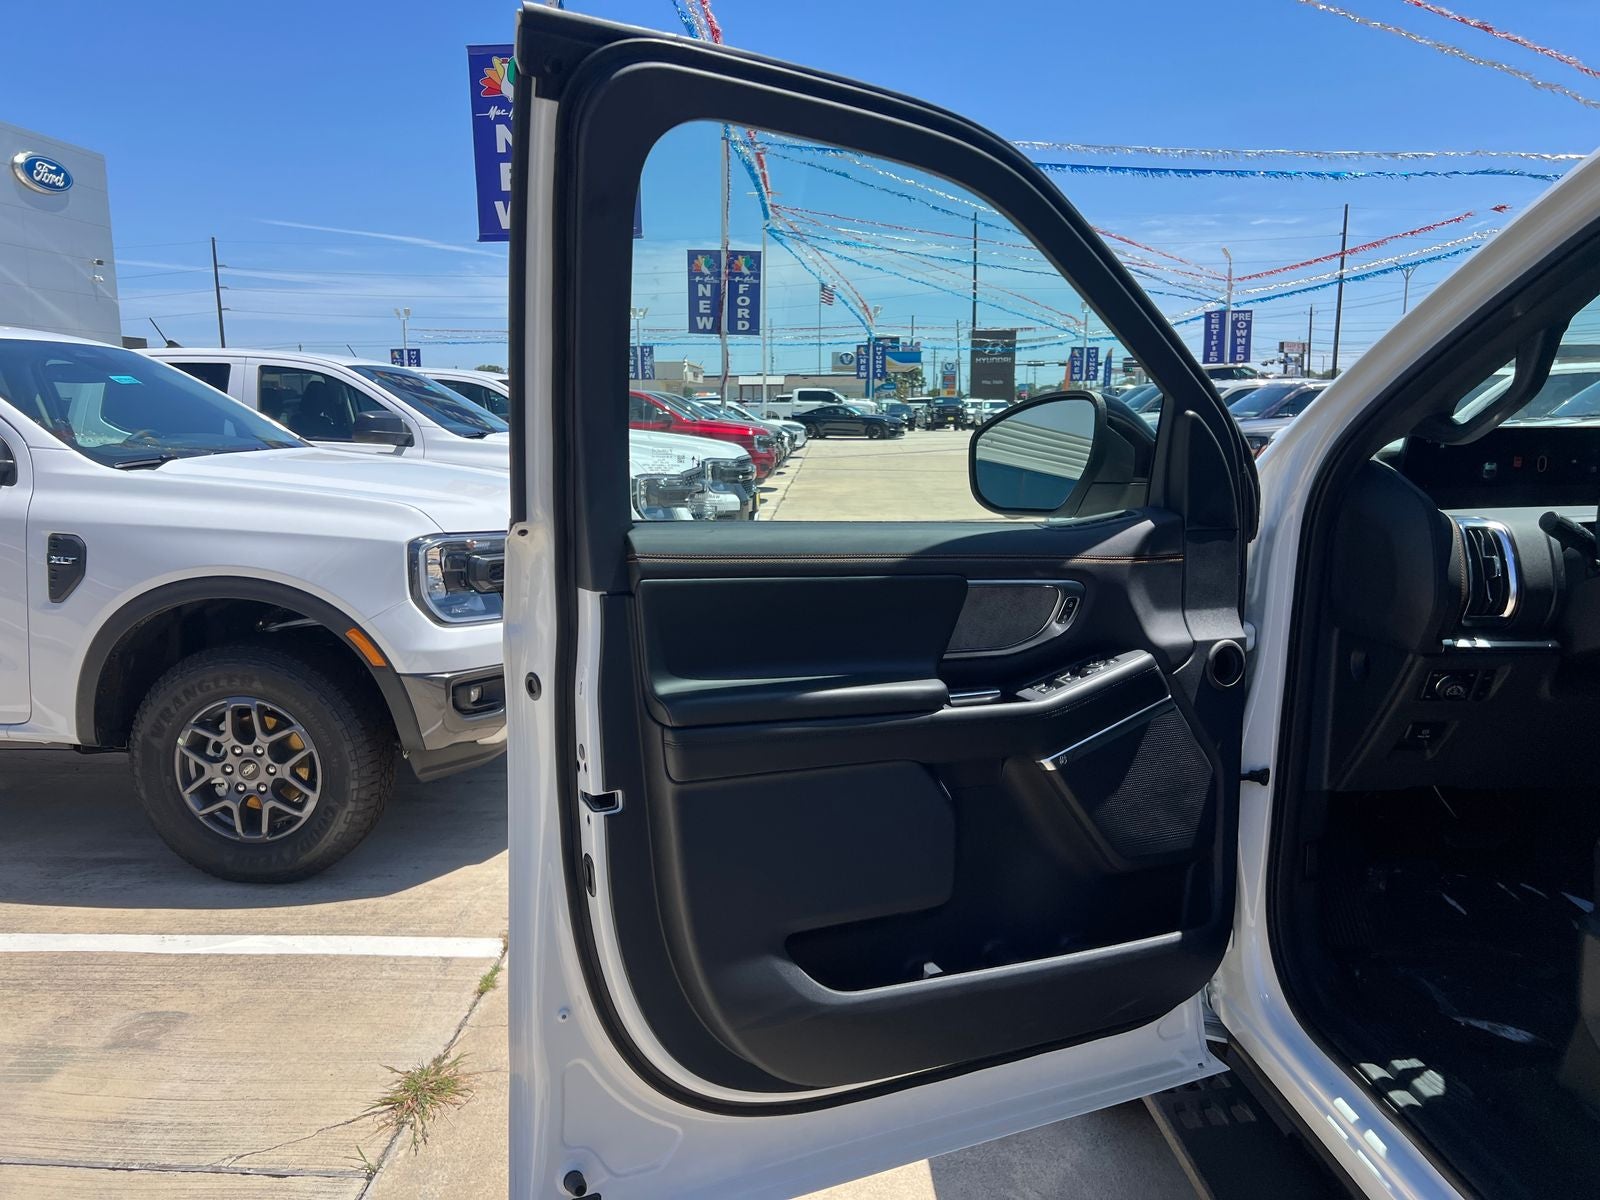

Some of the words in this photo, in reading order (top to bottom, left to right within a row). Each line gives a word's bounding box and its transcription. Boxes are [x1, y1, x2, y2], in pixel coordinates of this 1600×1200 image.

[33, 161, 65, 187] Ford
[696, 284, 714, 330] NEW
[736, 284, 750, 331] FORD
[1232, 312, 1251, 321] PRE
[1209, 312, 1220, 362] CERTIFIED
[1236, 321, 1247, 361] OWNED
[859, 358, 868, 378] NEW
[875, 346, 883, 378] HYUNDAI
[975, 356, 1012, 364] HYUNDAI
[1072, 360, 1081, 380] NEW
[1088, 348, 1097, 379] HYUNDAI
[50, 555, 78, 565] XLT
